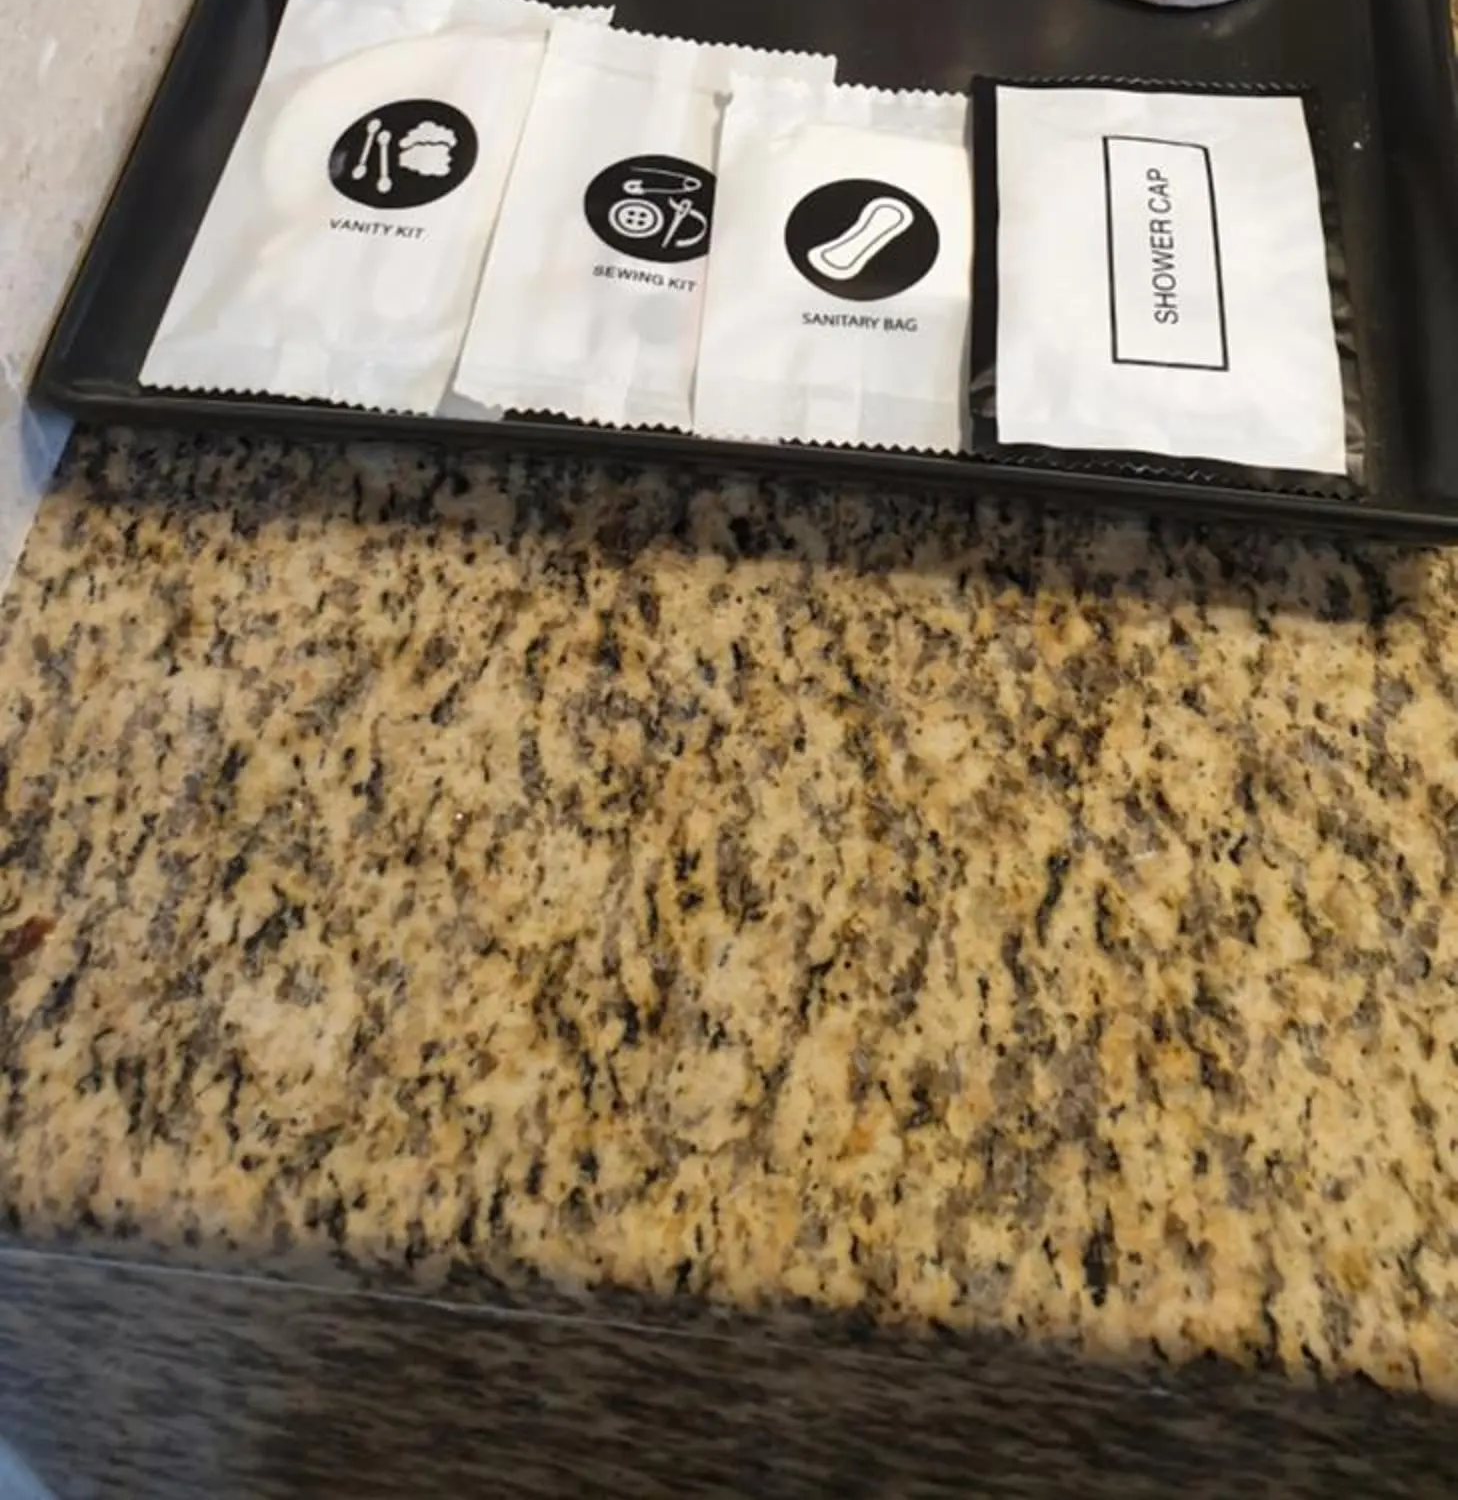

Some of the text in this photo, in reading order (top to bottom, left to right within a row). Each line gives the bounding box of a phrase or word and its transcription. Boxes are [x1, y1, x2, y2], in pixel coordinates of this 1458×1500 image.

[329, 219, 425, 239] VANITY KIT
[1146, 167, 1179, 325] SHOWER CAP
[592, 265, 696, 292] SEWING KIT
[802, 312, 918, 332] SANITARY BAG
